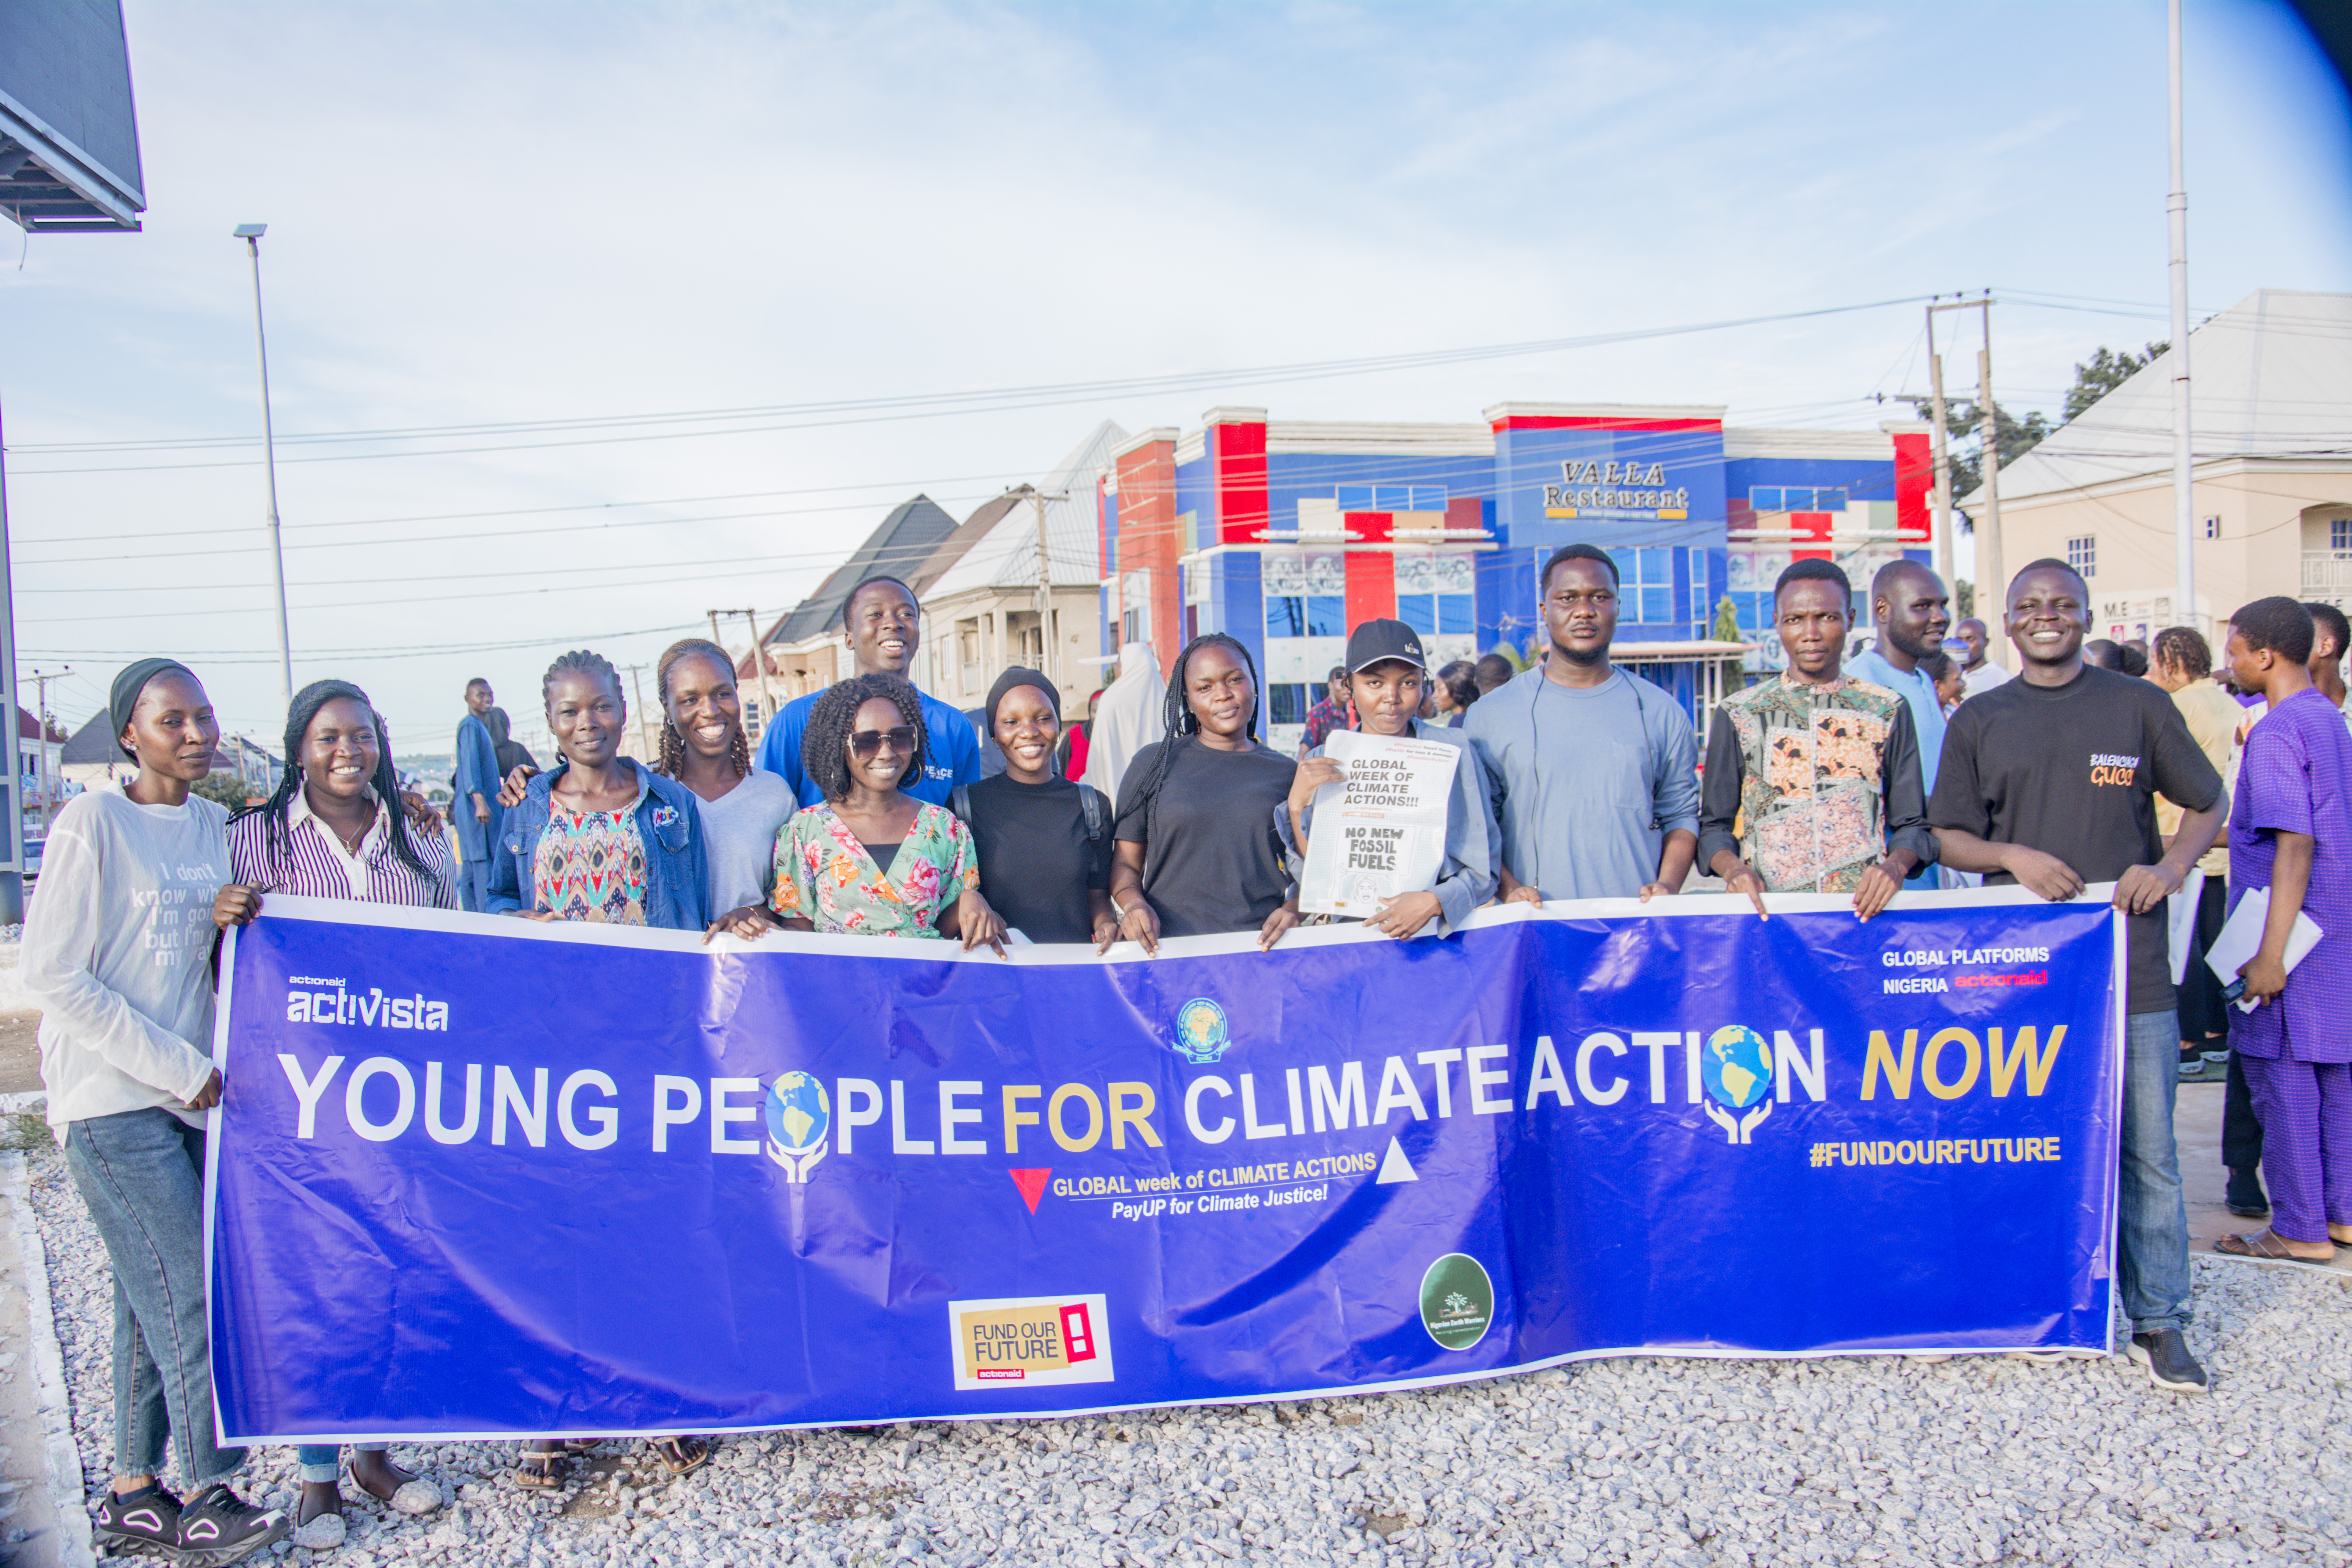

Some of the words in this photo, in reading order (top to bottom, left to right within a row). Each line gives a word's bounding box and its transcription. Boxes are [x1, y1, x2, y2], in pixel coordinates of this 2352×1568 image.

[1561, 460, 1666, 486] VALLA
[1543, 485, 1689, 509] Restaurant
[1352, 759, 1407, 769] GLOBAL
[1350, 771, 1390, 781] WEEK
[1395, 772, 1414, 781] OF
[1347, 783, 1409, 793] CLIMATE
[1344, 795, 1419, 807] ACTIONS!!!
[1345, 828, 1366, 838] NO
[1371, 828, 1404, 839] NEW
[1350, 839, 1397, 853] FOSSIL
[1348, 853, 1396, 871] FUELS
[161, 863, 170, 880] I
[177, 863, 218, 880] don't
[131, 888, 187, 907] know
[151, 907, 178, 925] I'm
[145, 929, 178, 949] but
[155, 949, 182, 969] my
[1882, 950, 1949, 966] GLOBAL
[1952, 947, 2050, 964] PLATFORMS
[1883, 978, 1949, 994] NIGERIA
[277, 1054, 618, 1151] YOUNG
[1002, 1082, 1163, 1153] FOR
[1185, 1044, 1513, 1144] CLIMATE
[1860, 1025, 2068, 1100] NOW
[1809, 1137, 2060, 1167] #FUNDOURFUTURE
[1053, 1176, 1131, 1196] GLOBAL
[1135, 1172, 1181, 1192] week
[1186, 1171, 1203, 1188] of
[1209, 1163, 1289, 1186] CLIMATE
[1294, 1152, 1376, 1179] ACTIONS
[1112, 1199, 1166, 1221] PayUP
[1170, 1198, 1193, 1214] for
[1198, 1193, 1259, 1212] Climate
[1263, 1184, 1328, 1206] Justice!
[974, 1324, 1017, 1340] FUND
[1021, 1322, 1056, 1338] OUR
[975, 1339, 1058, 1361] FUTURE
